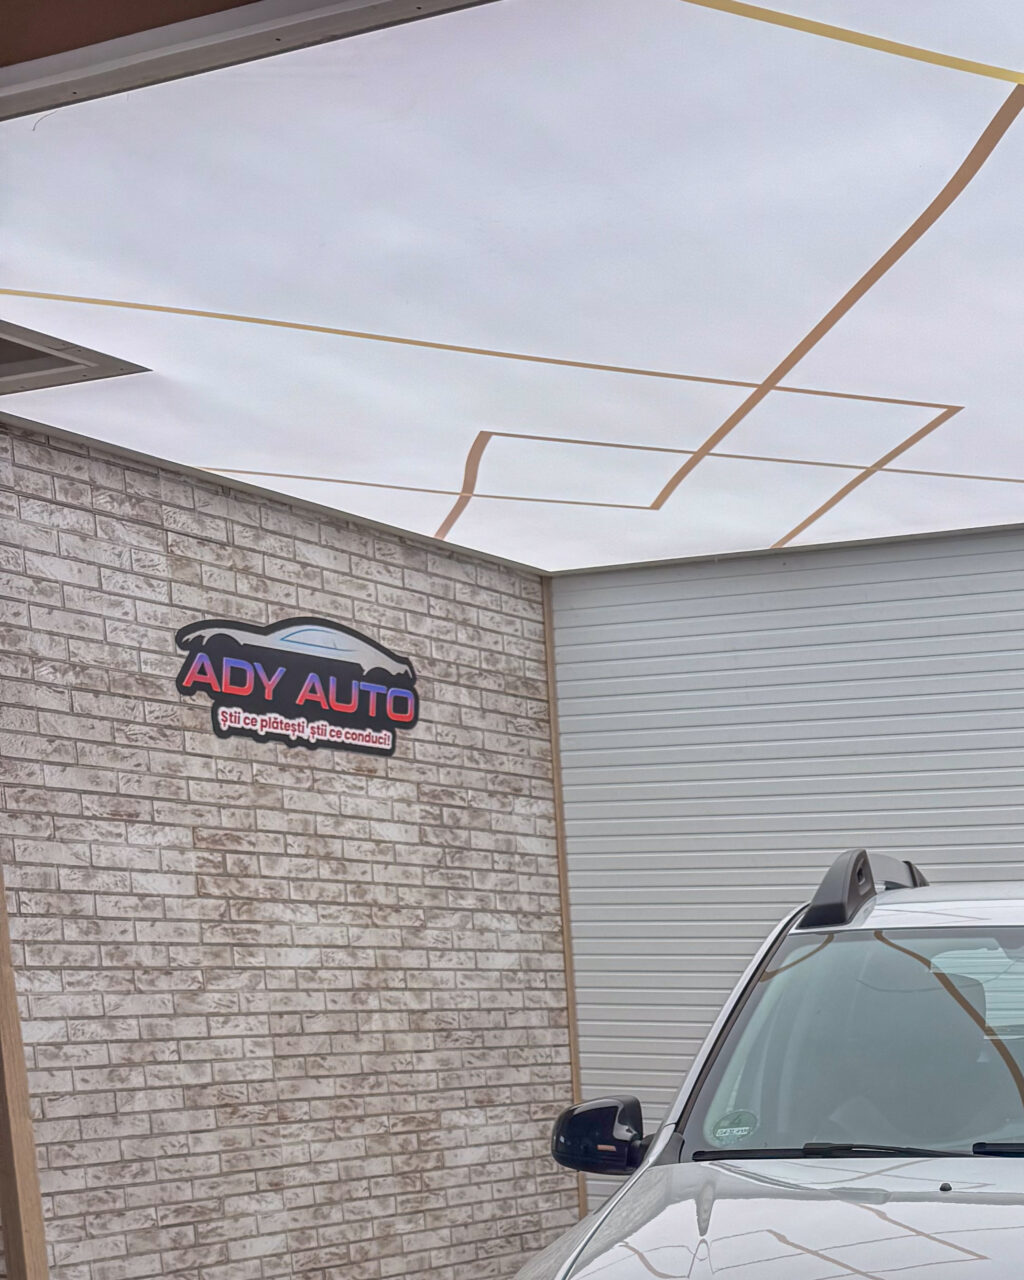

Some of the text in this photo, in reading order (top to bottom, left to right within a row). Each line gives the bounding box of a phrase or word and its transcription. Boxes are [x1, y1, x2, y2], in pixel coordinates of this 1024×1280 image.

[182, 652, 415, 722] ADY AUTO
[243, 715, 258, 727] ce
[329, 727, 342, 738] ce
[344, 731, 391, 746] conduci!
